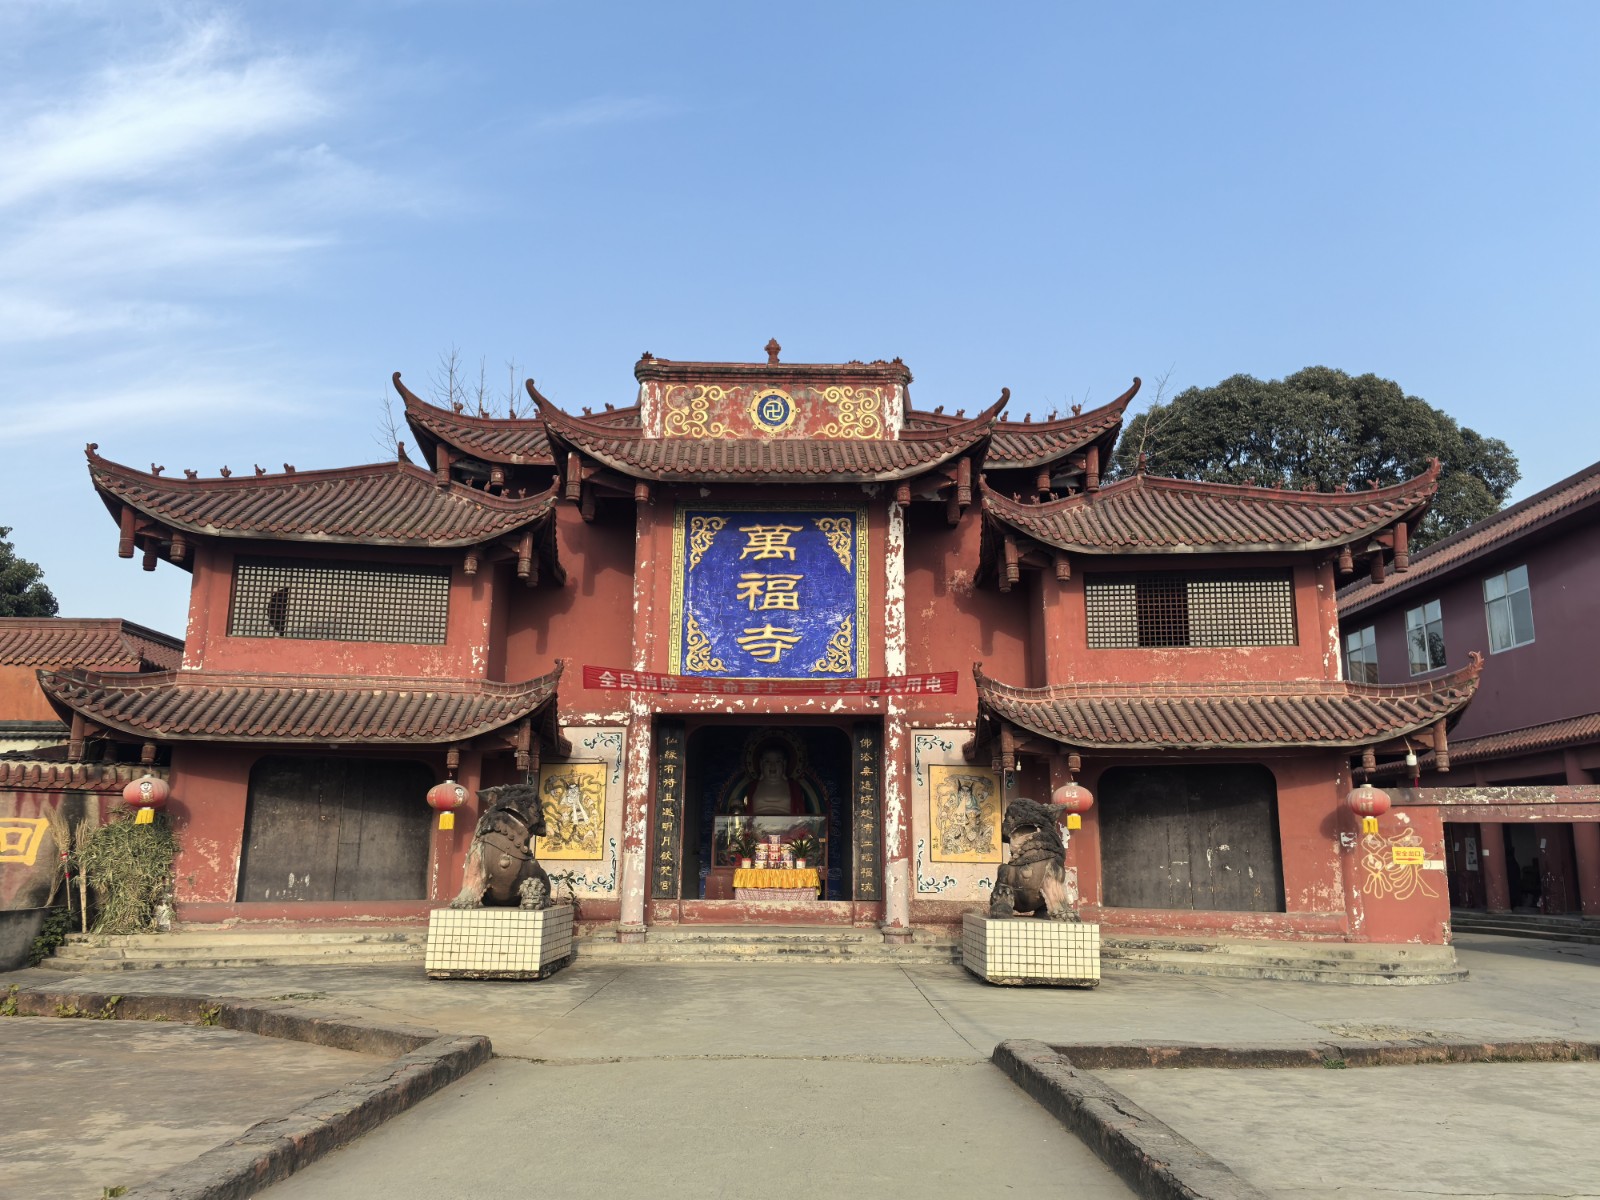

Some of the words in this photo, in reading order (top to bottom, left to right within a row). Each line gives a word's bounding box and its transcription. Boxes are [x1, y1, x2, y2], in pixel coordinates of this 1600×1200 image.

[736, 523, 804, 663] 萬福寺
[1394, 850, 1421, 858] 安全出口
